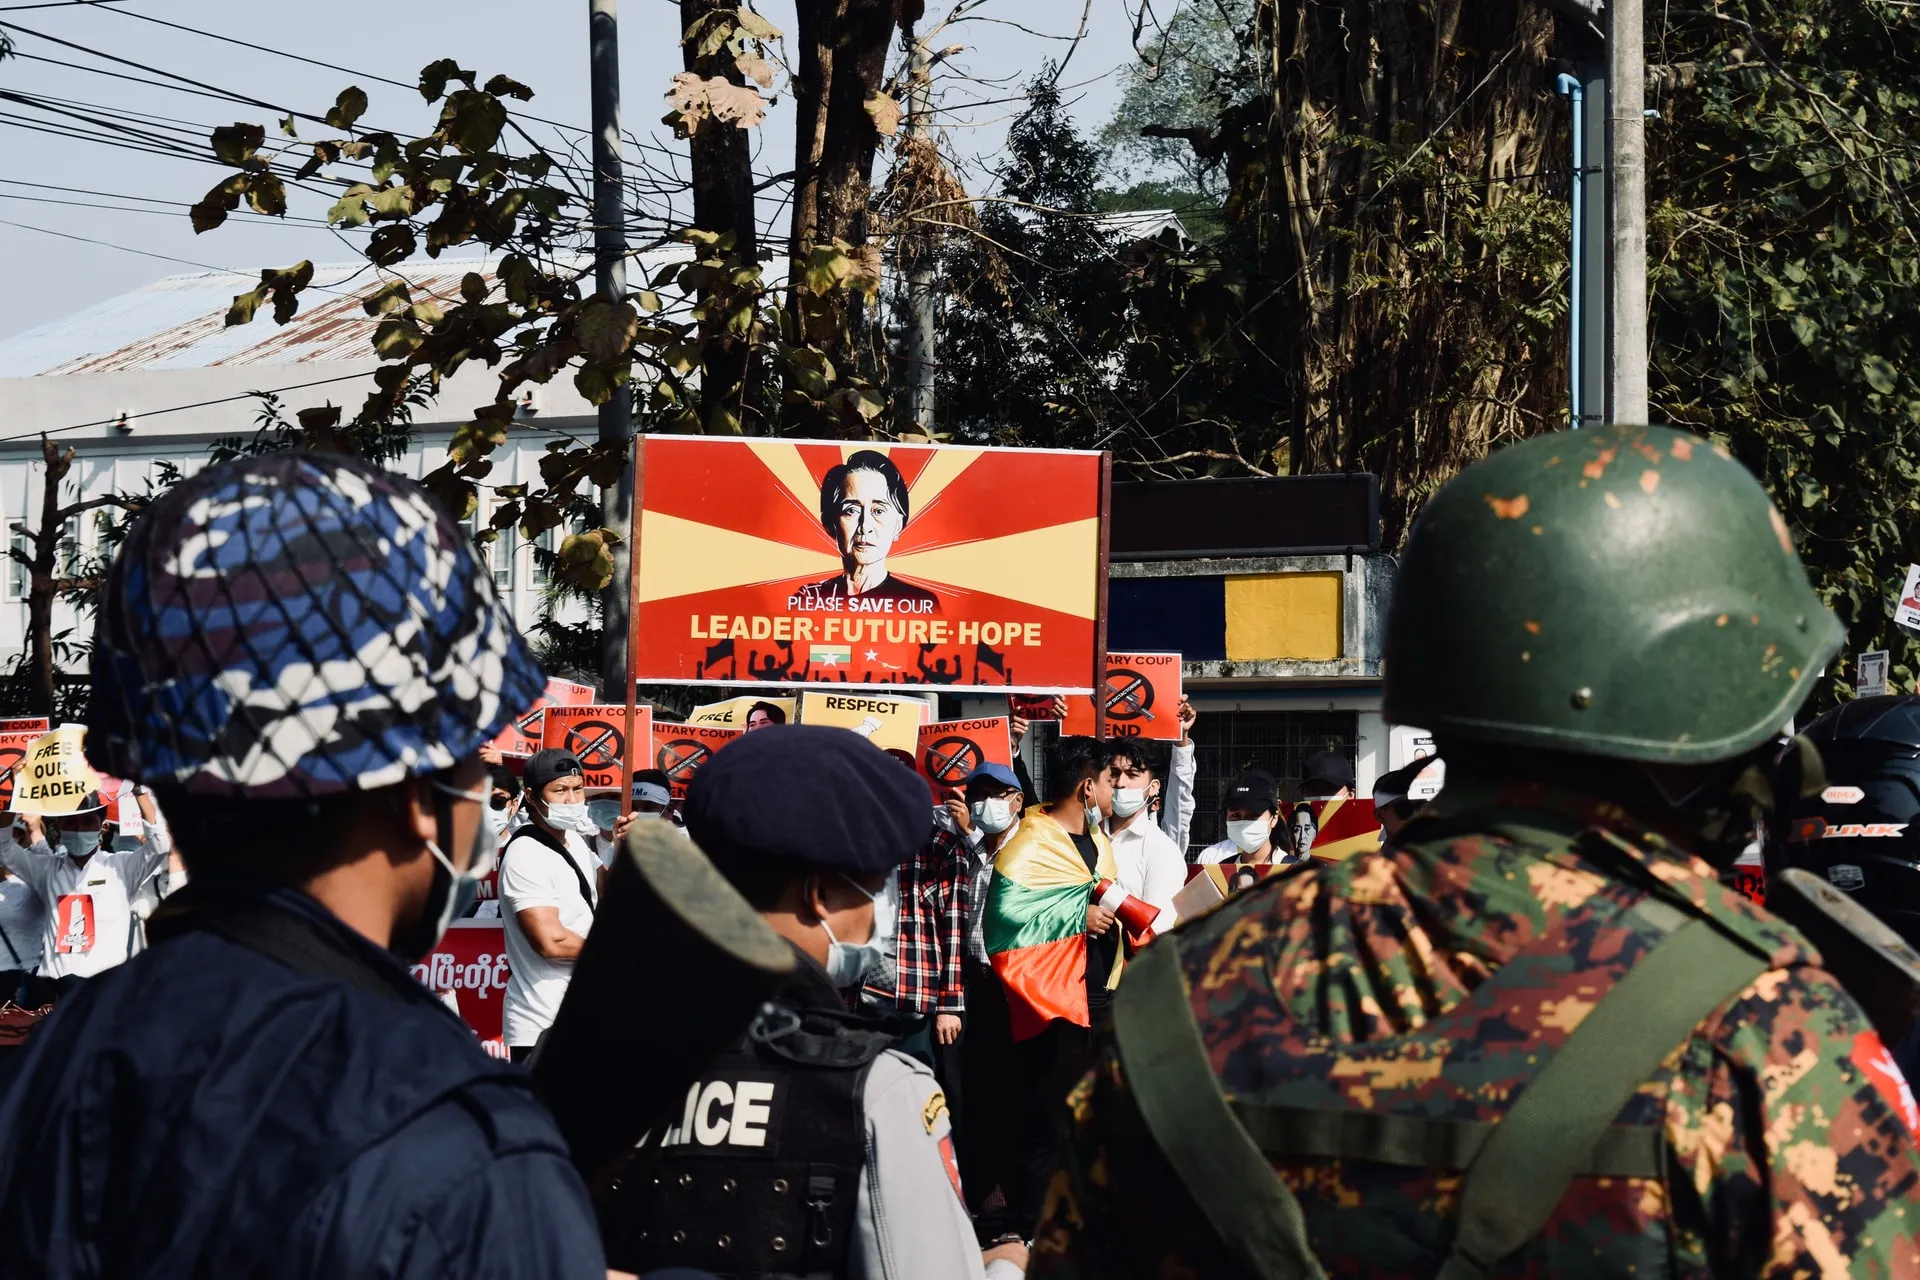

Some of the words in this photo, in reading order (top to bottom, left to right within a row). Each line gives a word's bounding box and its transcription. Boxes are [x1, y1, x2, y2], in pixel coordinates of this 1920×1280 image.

[787, 596, 844, 611] PLEASE
[848, 597, 893, 613] SAVE
[897, 599, 934, 614] OUR
[690, 615, 814, 641] LEADER
[823, 618, 948, 644] FUTURE
[958, 621, 1042, 646] HOPE
[1136, 655, 1173, 665] COUP
[553, 683, 587, 695] COUP
[550, 708, 602, 717] MILITARY
[606, 708, 643, 717] COP
[826, 697, 899, 715] RESPECT
[12, 719, 42, 730] COUP
[696, 711, 733, 722] FREE
[652, 723, 697, 737] ILITARY
[699, 728, 736, 739] COUP
[919, 724, 958, 735] LITARY
[962, 719, 1000, 731] COUP
[1105, 723, 1142, 737] END
[34, 741, 73, 760] FREE
[34, 761, 68, 779] OUR
[583, 774, 614, 786] ND
[19, 780, 86, 799] LEADER
[671, 787, 687, 798] EN
[634, 1080, 775, 1148] ICE
